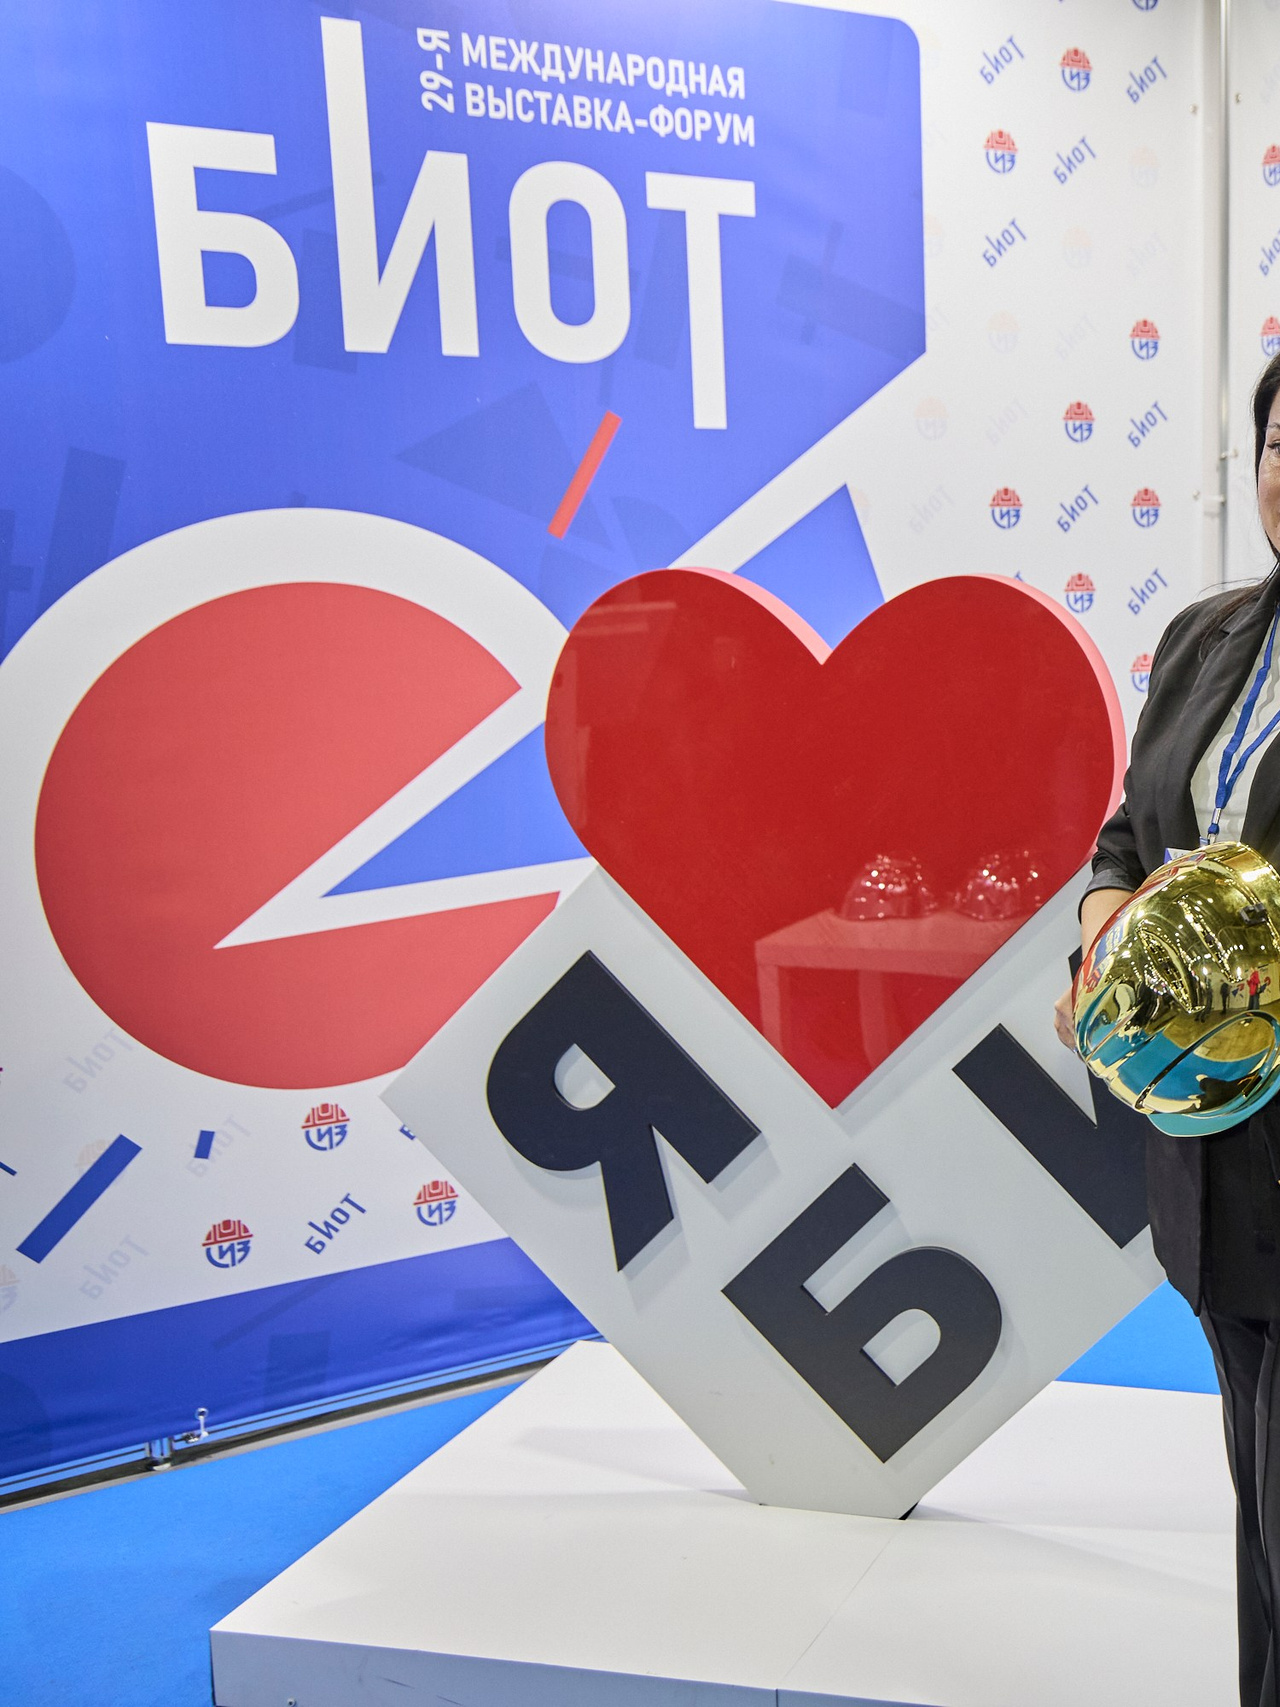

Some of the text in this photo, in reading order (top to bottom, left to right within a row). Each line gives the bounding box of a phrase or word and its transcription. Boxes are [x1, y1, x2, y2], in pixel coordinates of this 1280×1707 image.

[416, 27, 455, 114] 29-Я
[461, 32, 746, 100] МЕЖДУНАРОДНАЯ
[980, 34, 1025, 84] БИОТ
[1127, 55, 1168, 103] БИОТ
[465, 82, 756, 148] ВЫСТАВКА-ФОРУМ
[1053, 135, 1097, 184] БИОТ
[146, 16, 757, 430] БИОТ
[983, 217, 1028, 267] БИОТ
[1128, 400, 1169, 447] БИОТ
[1058, 483, 1100, 532] БИОТ
[1066, 593, 1094, 612] СИЗ
[1127, 568, 1168, 614] БИОТ
[1131, 671, 1149, 693] СИ
[486, 949, 761, 1272] Я
[304, 1123, 349, 1152] СИЗ
[305, 1193, 367, 1254] БИОТ
[417, 1200, 457, 1226] СИЗ
[205, 1240, 252, 1269] СИЗ
